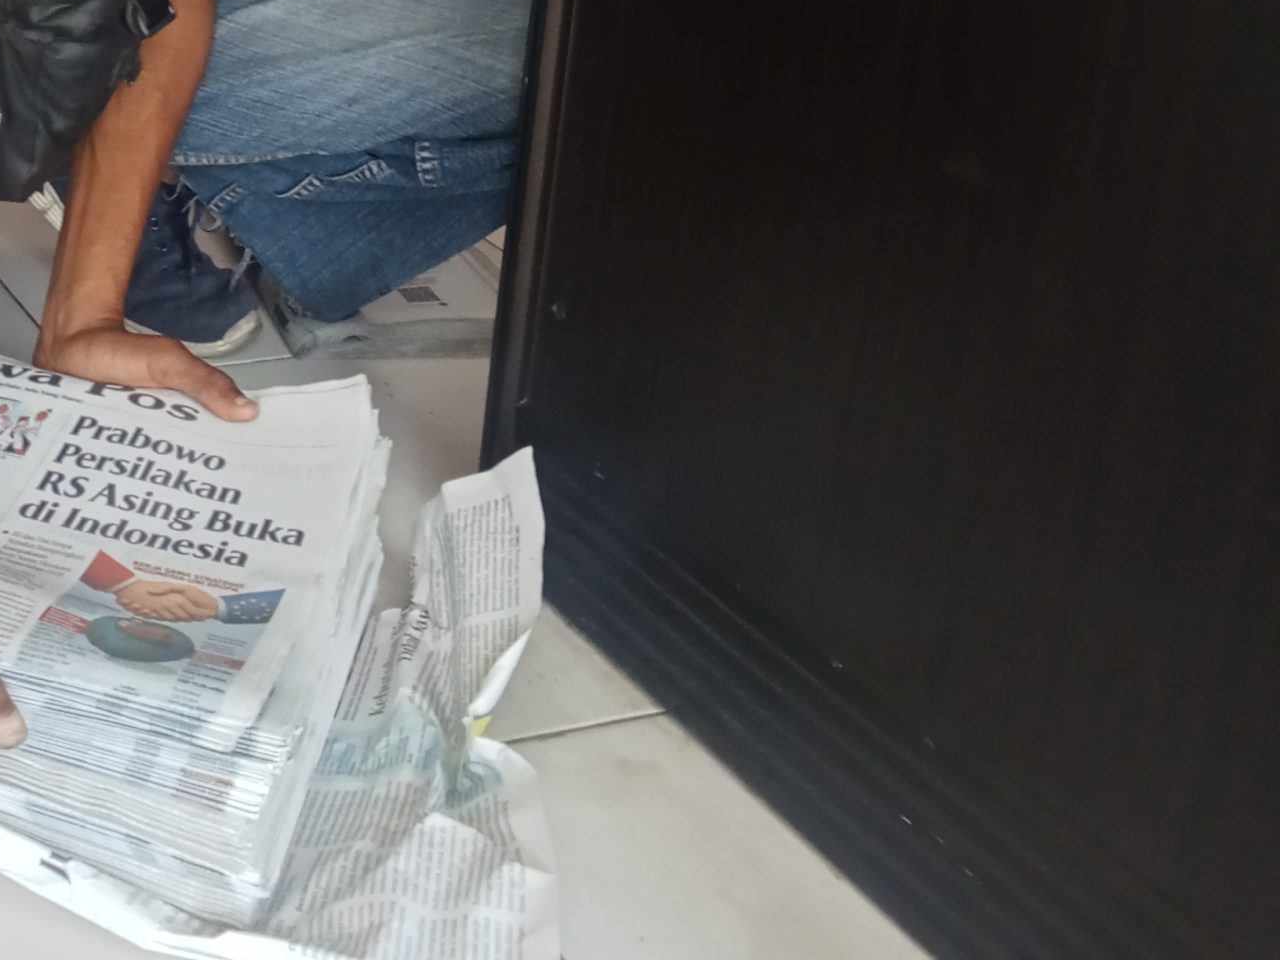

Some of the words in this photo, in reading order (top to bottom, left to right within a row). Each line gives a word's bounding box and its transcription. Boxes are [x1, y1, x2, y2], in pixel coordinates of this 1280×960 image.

[53, 442, 242, 505] Persilakan
[70, 415, 226, 471] Prabowo
[19, 501, 60, 523] di
[61, 514, 249, 568] Indonesia
[35, 470, 91, 499] RS
[89, 482, 199, 532] Asing
[204, 509, 306, 547] Buka
